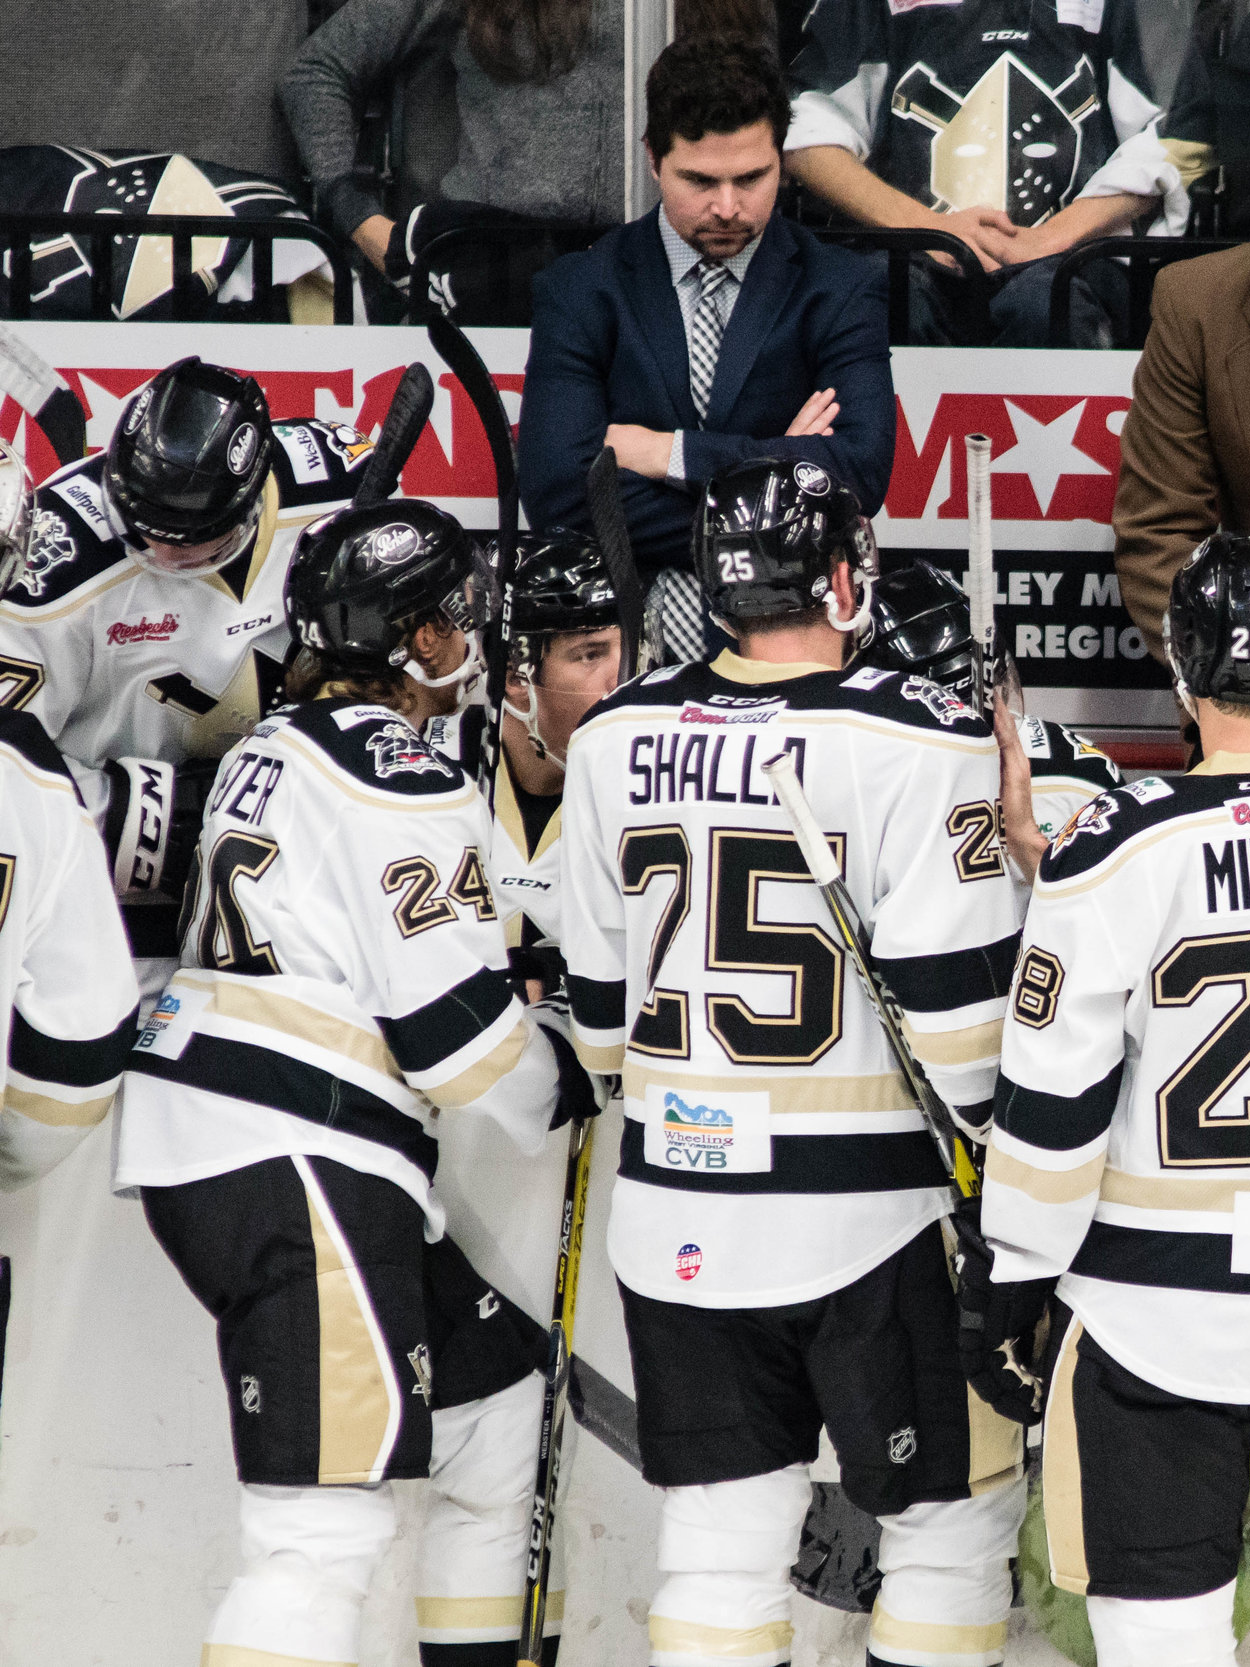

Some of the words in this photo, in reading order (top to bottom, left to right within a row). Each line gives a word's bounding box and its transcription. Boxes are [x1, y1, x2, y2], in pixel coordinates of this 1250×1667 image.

[981, 29, 1030, 42] CCM
[718, 551, 755, 583] 25
[226, 614, 272, 636] CCM
[708, 694, 781, 706] CCM
[129, 764, 164, 890] CCM
[380, 846, 498, 939] 24
[500, 876, 551, 891] CCM
[617, 823, 846, 1067] 25
[664, 1130, 735, 1147] Wheeling
[665, 1146, 728, 1169] CVB
[675, 1252, 703, 1273] ECHL
[528, 1493, 545, 1580] CCM
